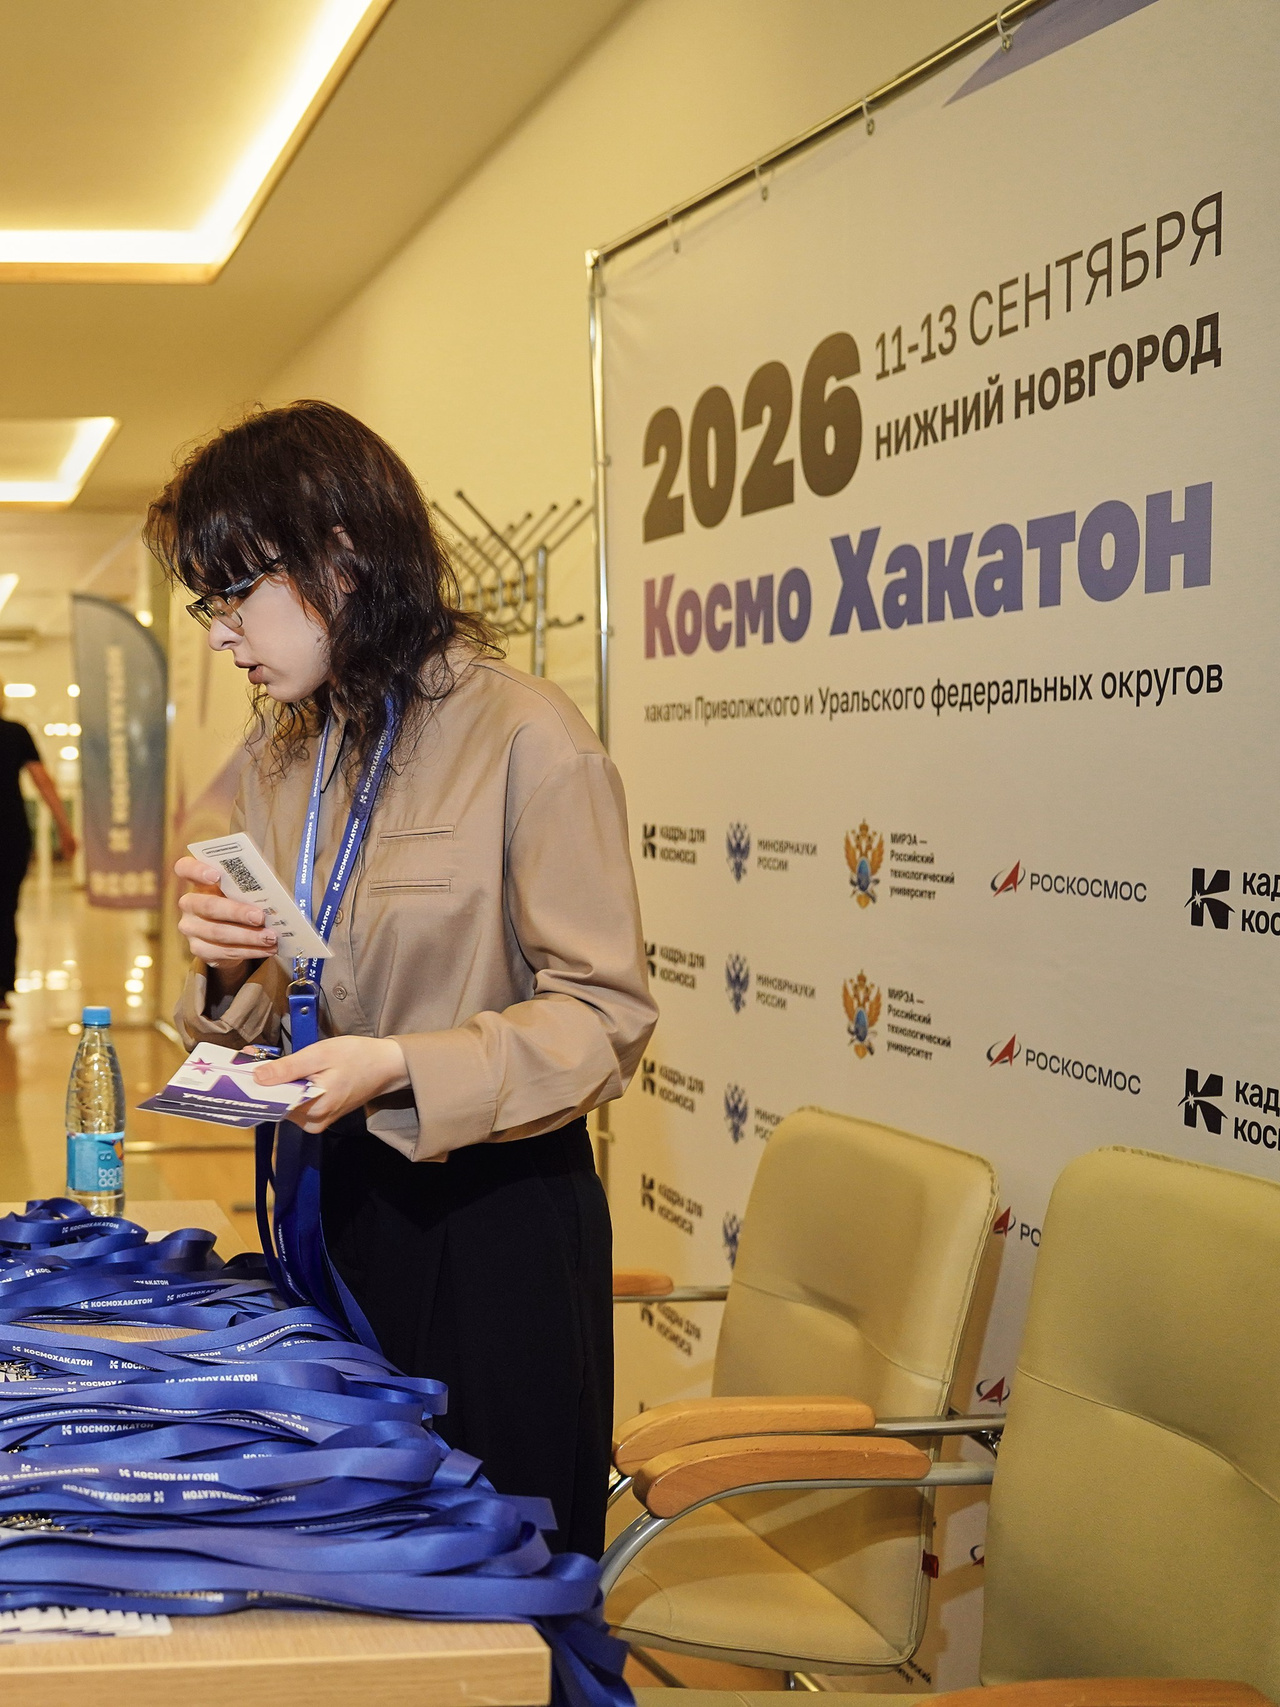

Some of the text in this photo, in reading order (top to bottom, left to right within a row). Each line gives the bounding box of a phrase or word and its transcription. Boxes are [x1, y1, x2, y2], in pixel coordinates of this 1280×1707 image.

[875, 191, 1222, 380] 11-13 СЕНТЯБРЯ
[875, 312, 1221, 460] НИЖНИЙ НОВГОРОД
[643, 331, 862, 543] 2026
[644, 481, 1213, 659] Космо Хакатон
[644, 663, 1223, 725] хакатон Приволжского и Уральского федеральных округов
[301, 822, 313, 884] КОСМОХАКАТОН
[337, 818, 360, 881] КОСМОХАКАТОН
[890, 850, 935, 864] Российский
[757, 856, 789, 872] РОССИИ
[890, 868, 955, 884] технологический
[889, 885, 937, 901] университет
[1030, 872, 1147, 903] РОСКОСМОС
[320, 905, 332, 939] АКАТОН
[887, 1005, 931, 1025] Российский
[887, 1023, 951, 1048] технологический
[1025, 1049, 1142, 1096] РОСКОСМОС
[1234, 1116, 1280, 1151] кос
[70, 1221, 119, 1232] КОСМОХАКАТОН
[91, 1298, 153, 1308] КОСМОХАКАТОН
[24, 1348, 93, 1367] КОСМОХАКАТОН
[17, 1409, 98, 1421] КОСМОХАКАТОН
[75, 1423, 154, 1434] КОСМОХАКАТОН
[13, 1468, 100, 1479] КОСМОХАКАТОН
[133, 1471, 219, 1482] КОСМОХАКАТОН
[62, 1484, 151, 1502] КОСМОХАКАТОН
